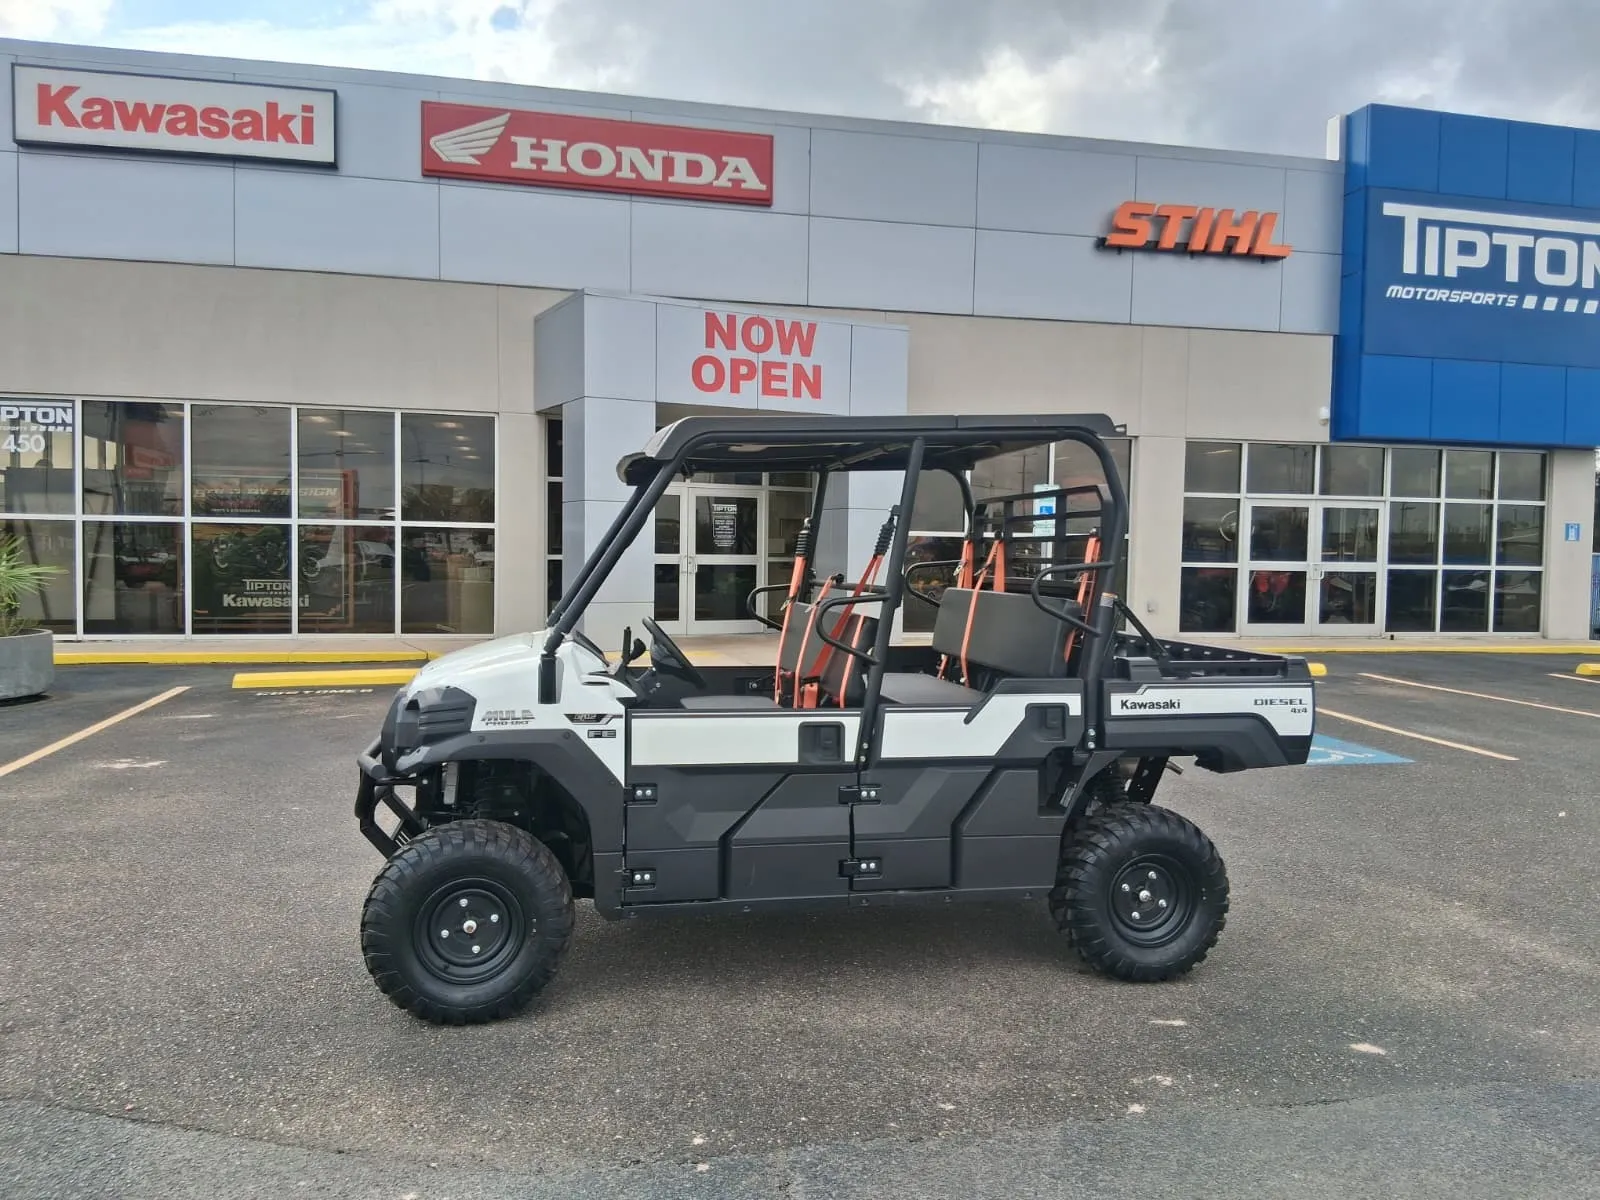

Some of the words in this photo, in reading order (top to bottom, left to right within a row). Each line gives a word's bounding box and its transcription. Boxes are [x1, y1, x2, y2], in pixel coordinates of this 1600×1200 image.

[37, 83, 315, 146] Kawasaki
[510, 135, 767, 191] HONDA
[1105, 200, 1293, 257] STIHL
[1386, 284, 1519, 308] MOTORSPORTS
[704, 311, 818, 358] NOW
[691, 354, 822, 400] OPEN
[0, 401, 73, 424] PTON
[1, 433, 46, 453] 450
[242, 579, 292, 591] TIPTON
[1120, 699, 1181, 710] Kawasaki
[1253, 698, 1308, 706] DIESEL
